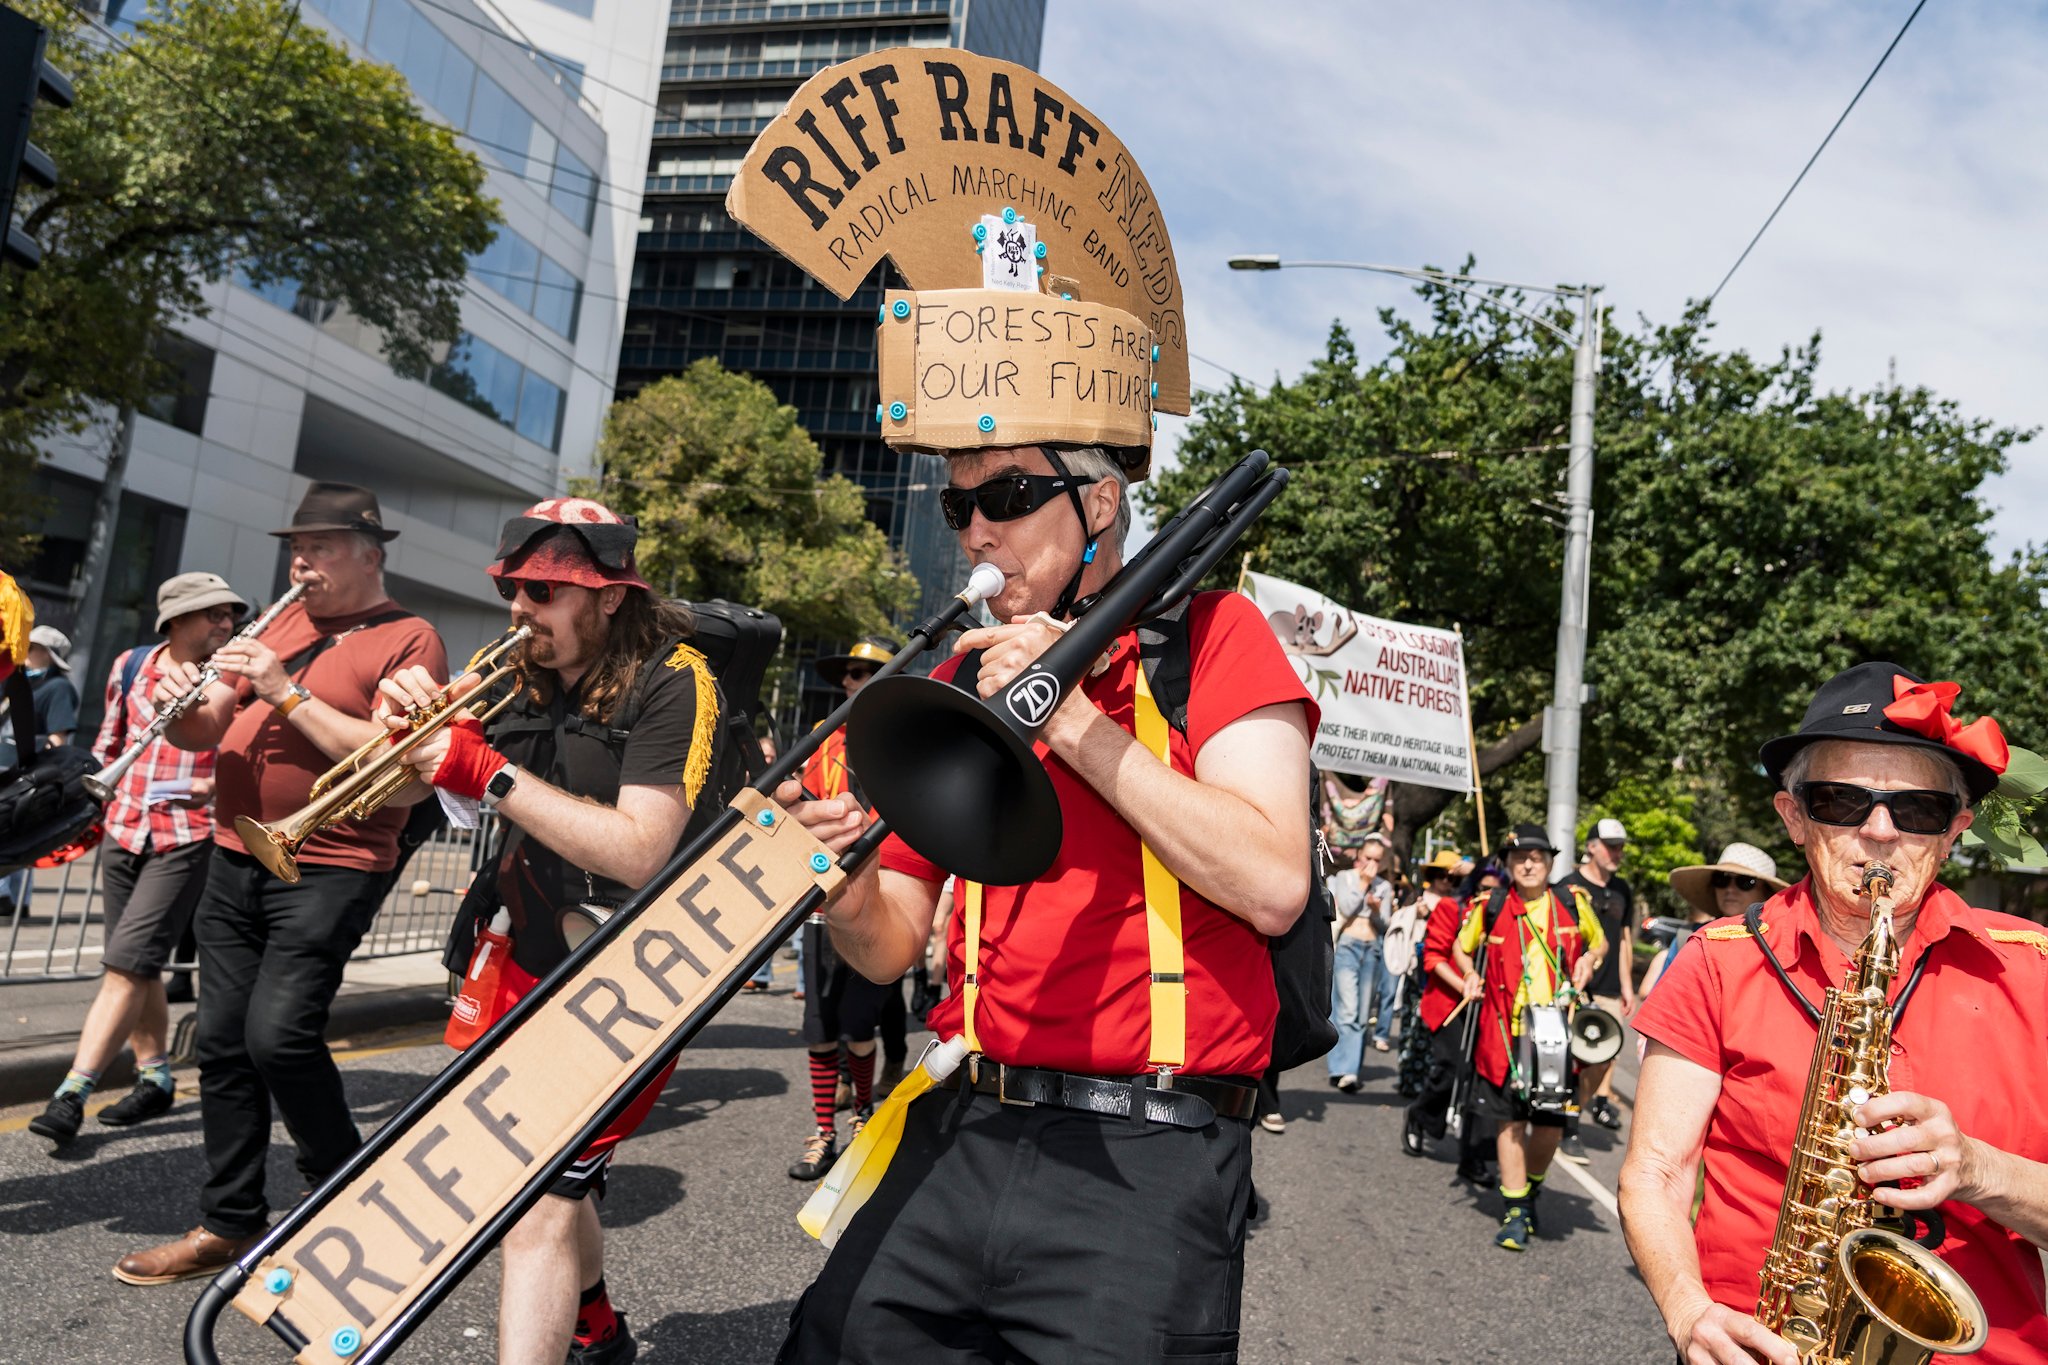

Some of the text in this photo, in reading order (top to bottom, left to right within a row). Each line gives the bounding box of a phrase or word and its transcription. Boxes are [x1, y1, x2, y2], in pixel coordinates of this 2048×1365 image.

[761, 63, 905, 232] RIFF
[828, 171, 937, 271] RADICAL
[952, 165, 1077, 233] MARCHING
[1083, 229, 1130, 289] BAND
[915, 303, 1147, 362] FORESTS ARE
[921, 359, 1150, 414] OUR FUTURE
[1398, 630, 1459, 663] LOGGING
[1344, 669, 1463, 718] NATIVE FORESTS
[1316, 742, 1361, 760] PROTECT
[1361, 749, 1388, 765] THEM
[1389, 754, 1399, 768] IN
[1400, 757, 1441, 775] NATIONAL
[1342, 726, 1368, 742] THEIR
[1369, 729, 1402, 747] WORLD
[1402, 736, 1442, 755] HERITAGE
[293, 831, 777, 1329] RIFF RAFF
